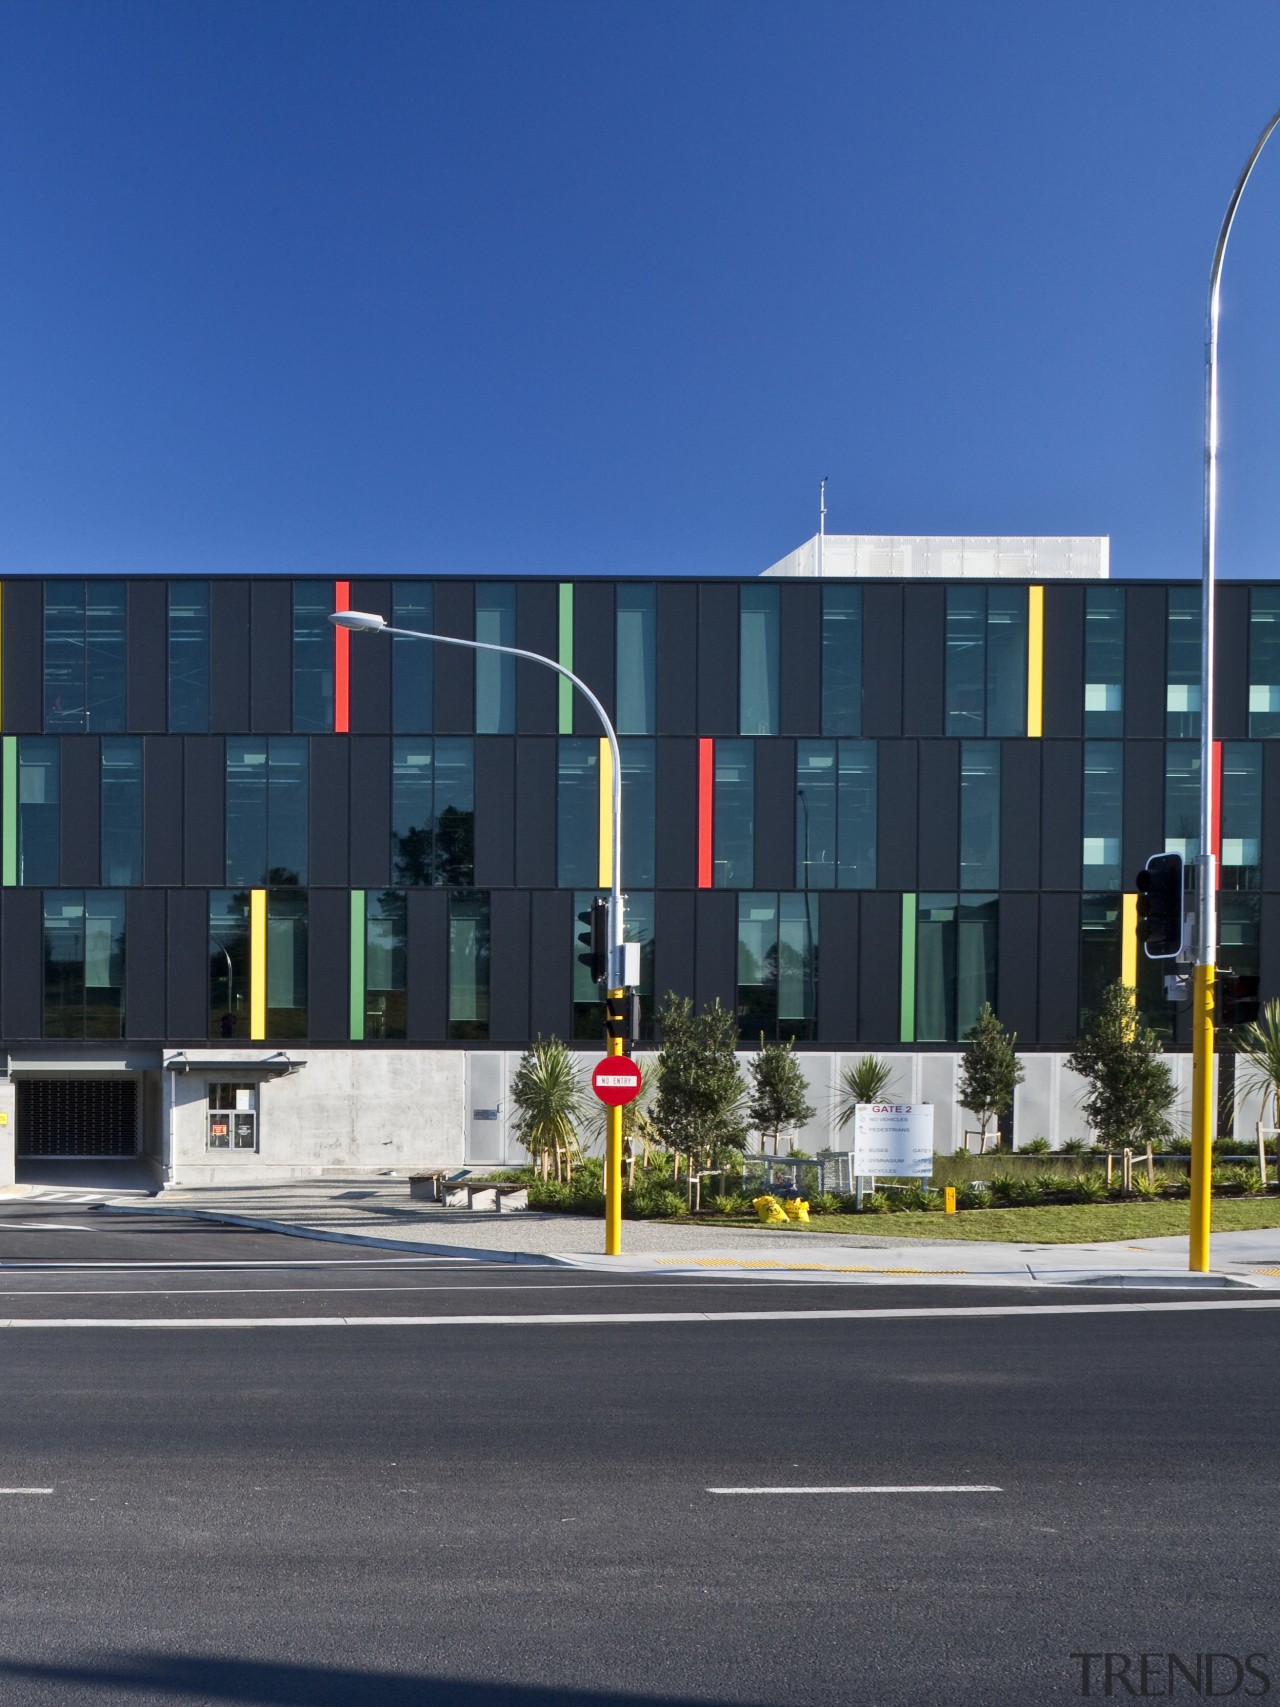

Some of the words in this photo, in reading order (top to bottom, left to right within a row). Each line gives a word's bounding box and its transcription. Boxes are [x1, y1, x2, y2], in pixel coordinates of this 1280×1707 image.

[601, 1077, 610, 1085] NO
[613, 1077, 631, 1085] ENTRY
[872, 1105, 902, 1113] GATE
[905, 1105, 912, 1113] 2
